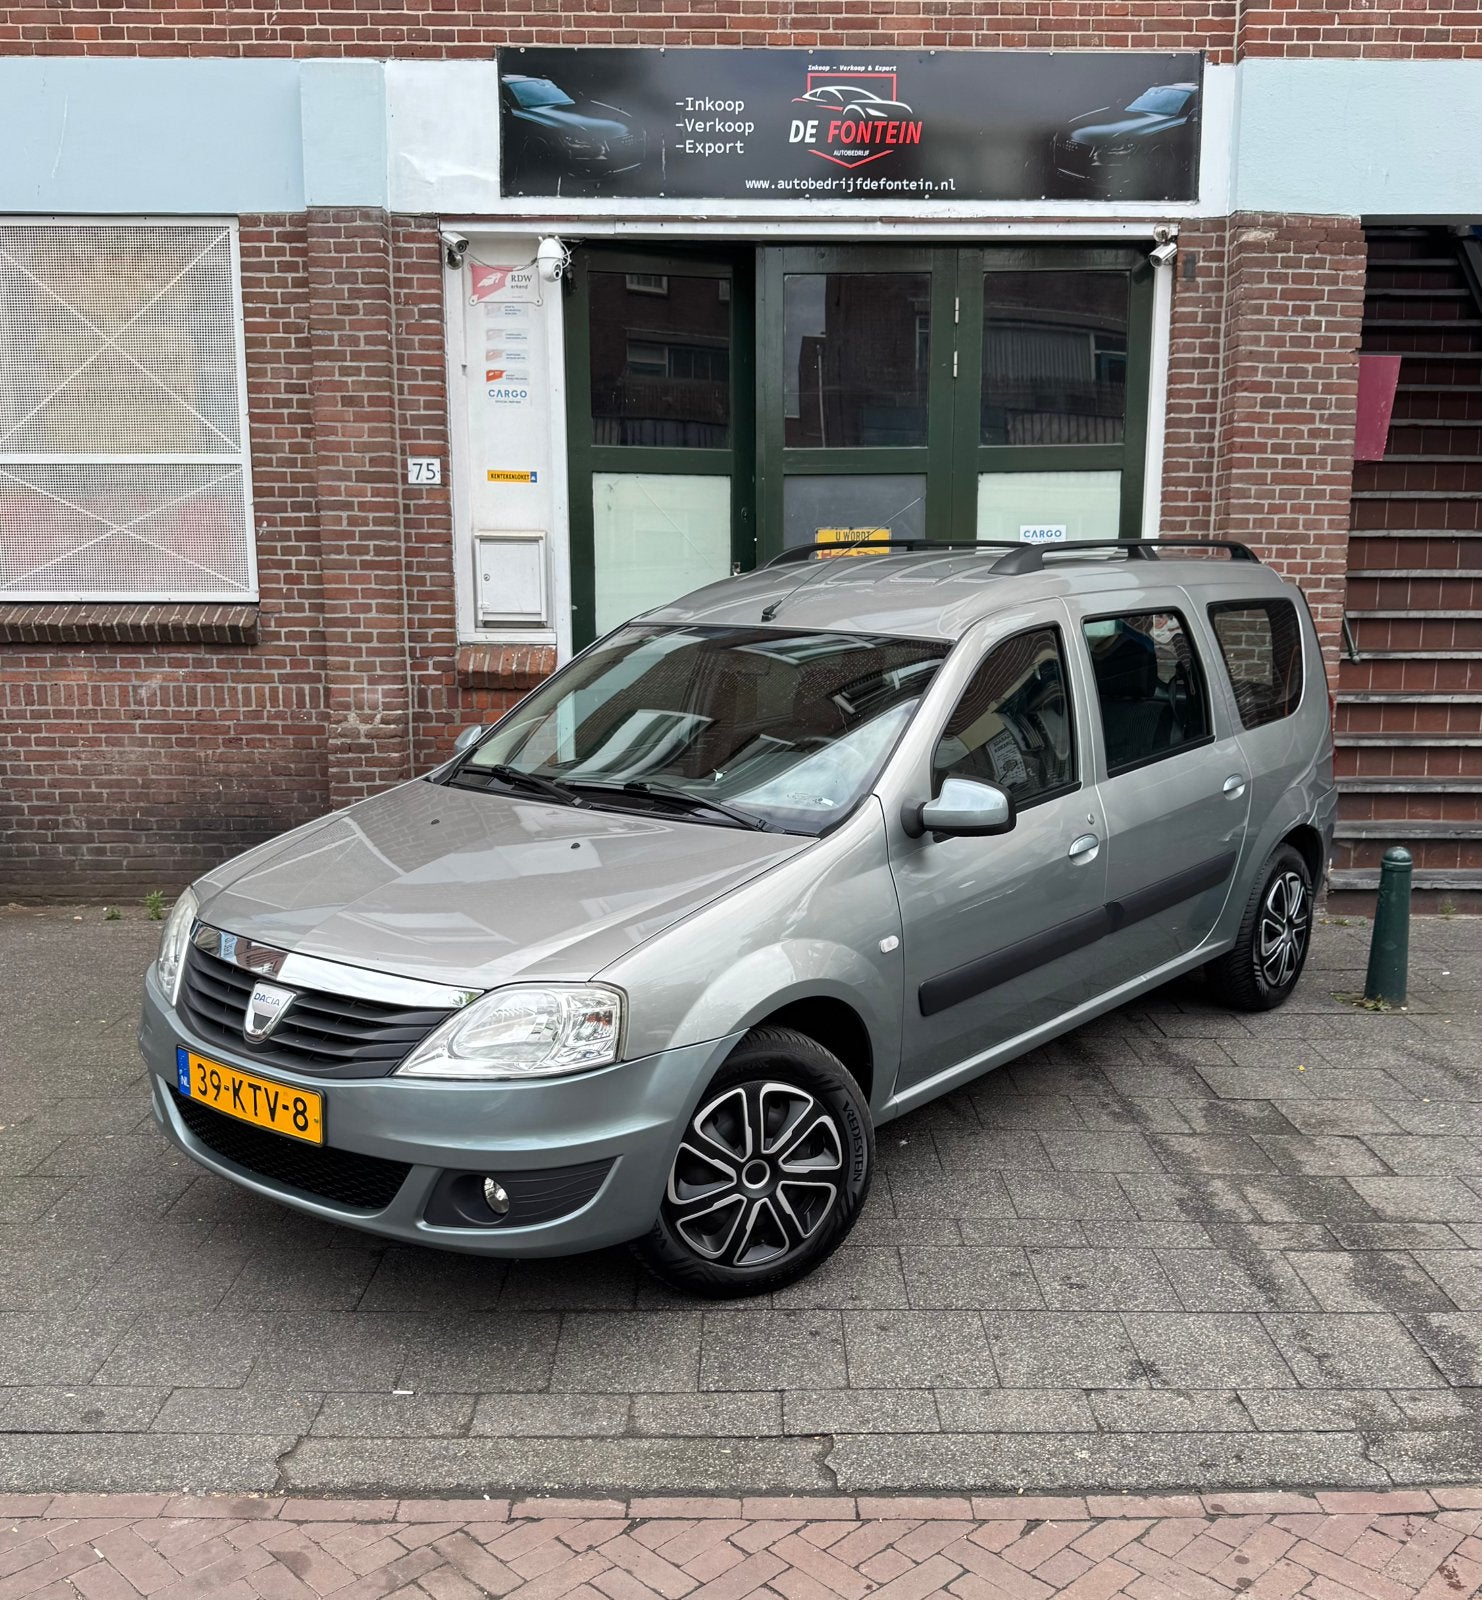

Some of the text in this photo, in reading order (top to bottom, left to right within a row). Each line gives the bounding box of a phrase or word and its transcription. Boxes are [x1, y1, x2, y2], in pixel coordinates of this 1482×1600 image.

[789, 120, 923, 144] DE FONTEIN
[745, 178, 956, 192] www.autobedrijfdefontein.nl
[511, 274, 533, 282] RDW
[488, 389, 527, 398] CARGO
[412, 463, 436, 480] 75
[835, 531, 871, 541] U WORDT
[1023, 529, 1062, 538] CARGO
[253, 992, 281, 1007] DACIA
[180, 1075, 189, 1087] NL
[197, 1063, 309, 1132] 39-KTV-8
[842, 1100, 864, 1182] VREDESTEIN
